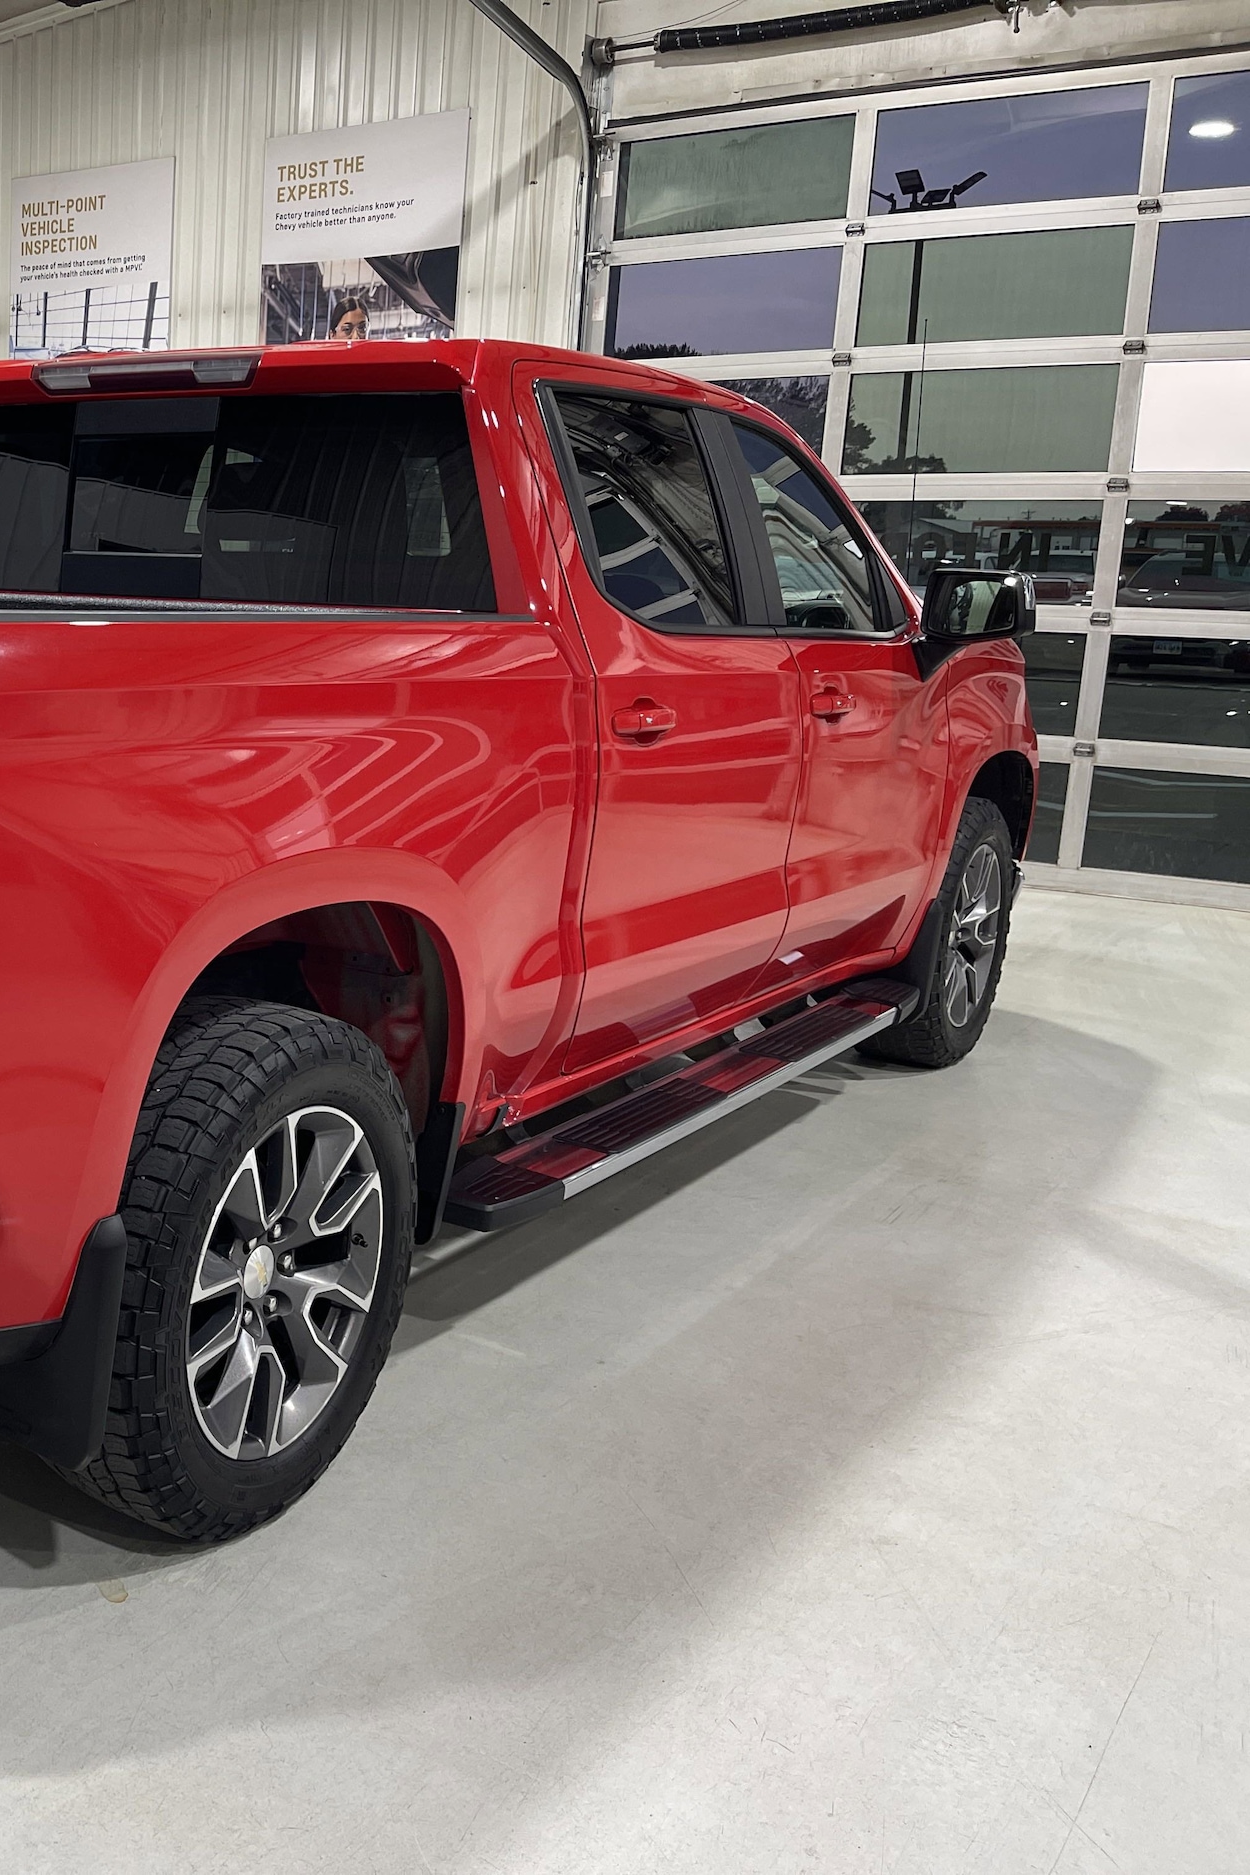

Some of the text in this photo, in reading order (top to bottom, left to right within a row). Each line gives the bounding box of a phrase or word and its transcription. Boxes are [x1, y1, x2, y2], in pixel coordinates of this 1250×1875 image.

[277, 156, 365, 183] TRUST THE
[276, 179, 354, 203] EXPERTS.
[21, 195, 106, 219] MULTI-POINT
[275, 198, 414, 220] Factory trained technicians know your
[21, 218, 75, 237] VEHICLE
[275, 214, 396, 231] Chevy vehicle better than anyone.
[21, 235, 98, 256] INSPECTION
[20, 275, 33, 283] your
[34, 272, 59, 280] vehicle's
[59, 270, 79, 278] health
[79, 267, 104, 276] checked
[105, 266, 119, 274] with
[32, 264, 49, 273] peace
[49, 262, 57, 270] of
[57, 261, 72, 269] mind
[123, 255, 146, 264] getting
